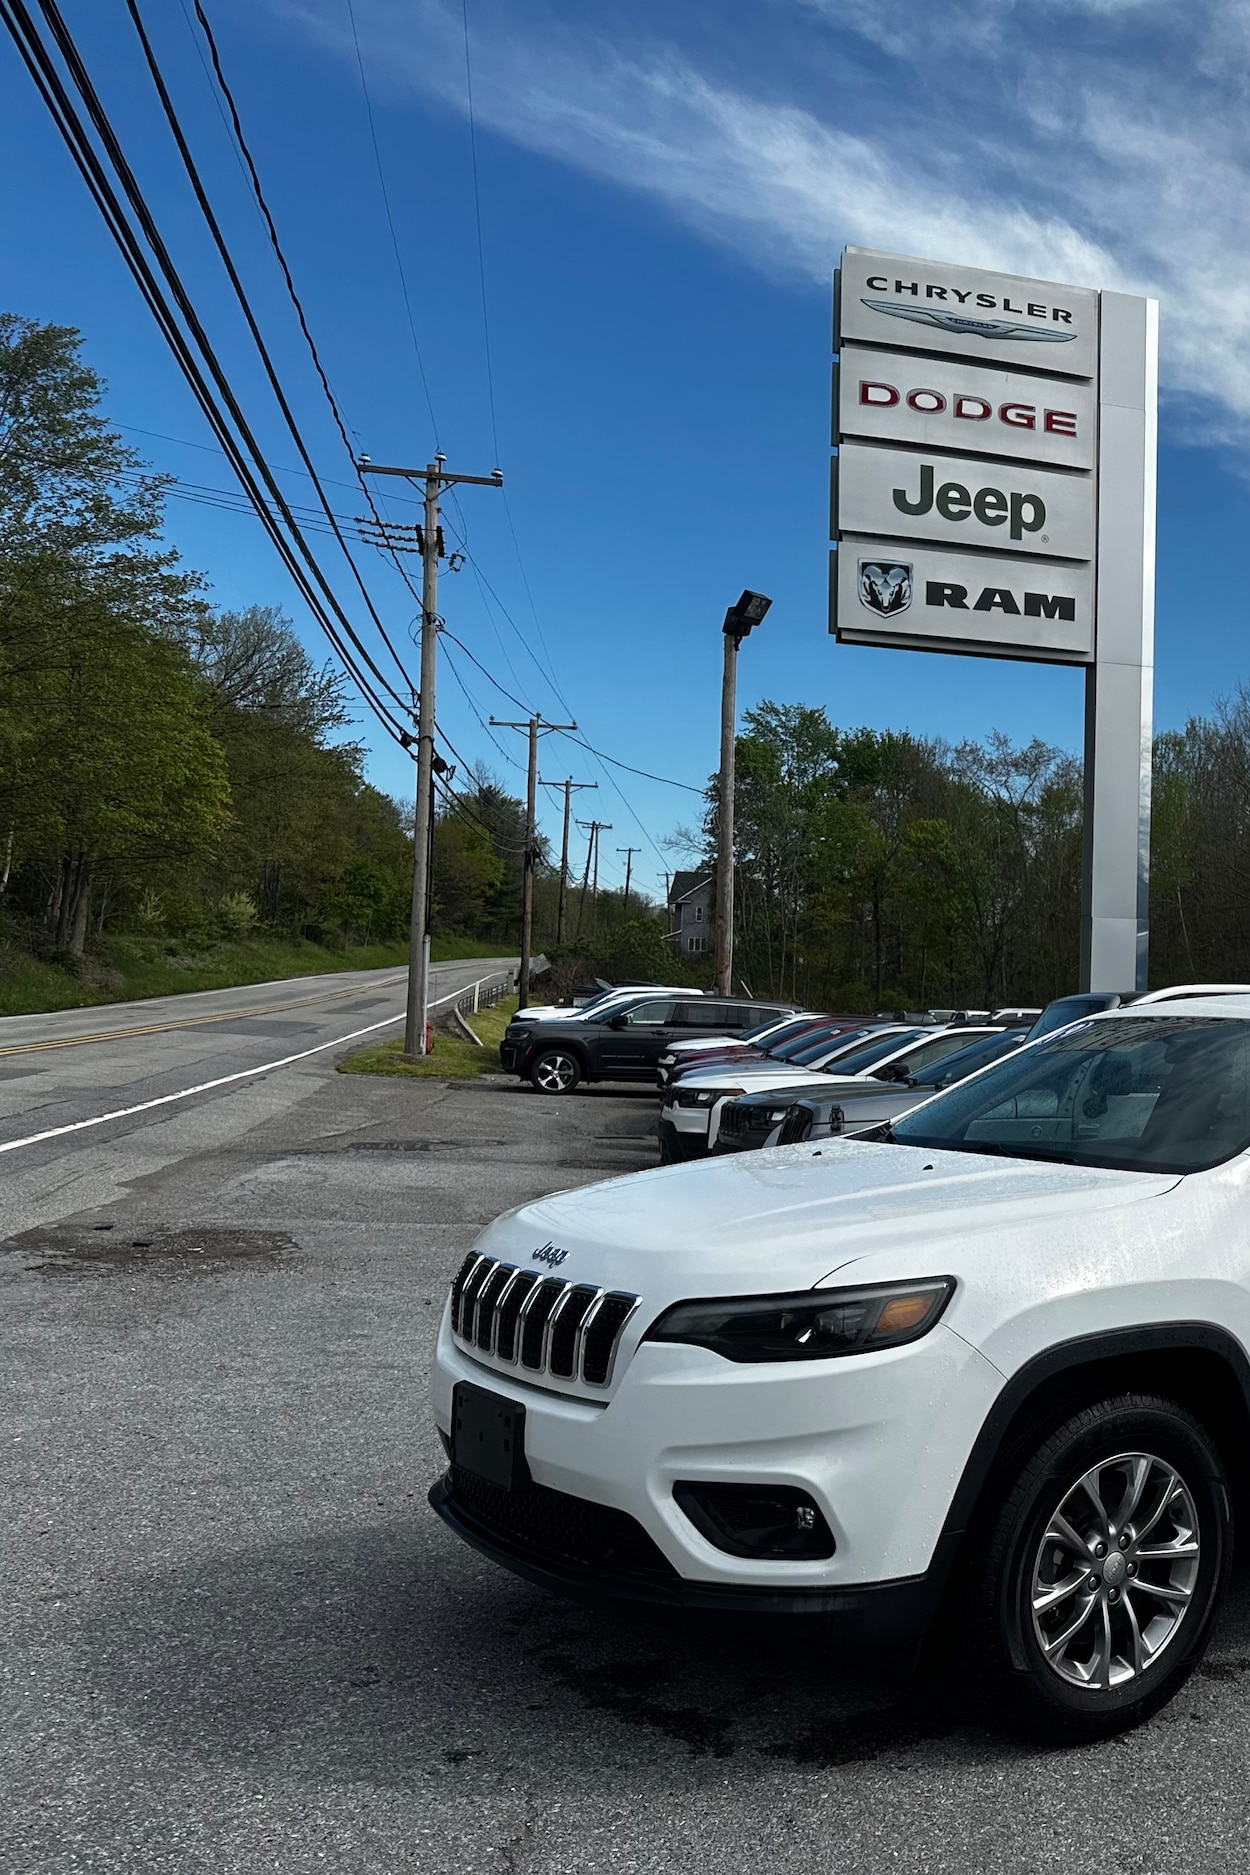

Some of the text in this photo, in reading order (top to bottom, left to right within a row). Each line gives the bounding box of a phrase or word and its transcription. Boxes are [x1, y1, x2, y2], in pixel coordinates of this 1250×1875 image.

[866, 276, 1073, 324] CHRYSLER
[859, 380, 1077, 438] DODGE
[892, 464, 1046, 541] Jeep
[925, 581, 1076, 622] RAM
[532, 1241, 570, 1268] Jeep
